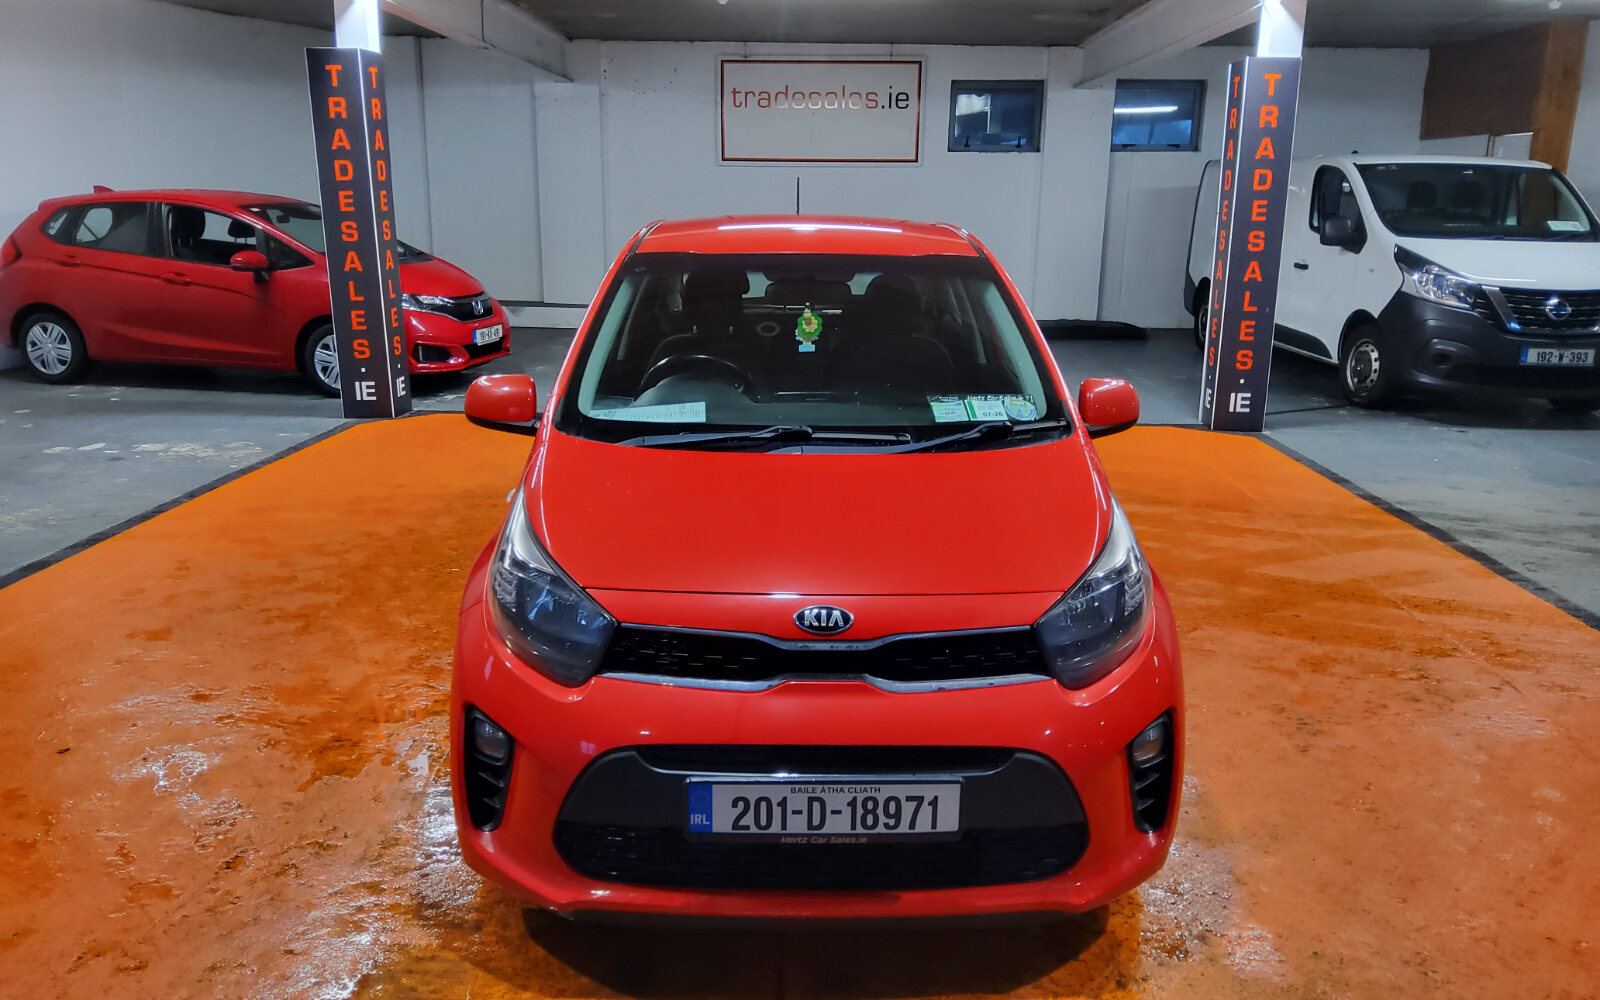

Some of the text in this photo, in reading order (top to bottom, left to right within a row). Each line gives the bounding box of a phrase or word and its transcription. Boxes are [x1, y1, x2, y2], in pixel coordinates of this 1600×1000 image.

[730, 84, 910, 110] tradesales.ie
[1536, 351, 1589, 363] 192-W-393
[803, 608, 845, 627] KIA
[790, 786, 817, 794] BAILE
[847, 786, 881, 794] CLIATH
[690, 813, 710, 825] IRL
[731, 795, 939, 832] 201-D-18971
[780, 835, 808, 844] Hertz
[810, 835, 827, 844] Car
